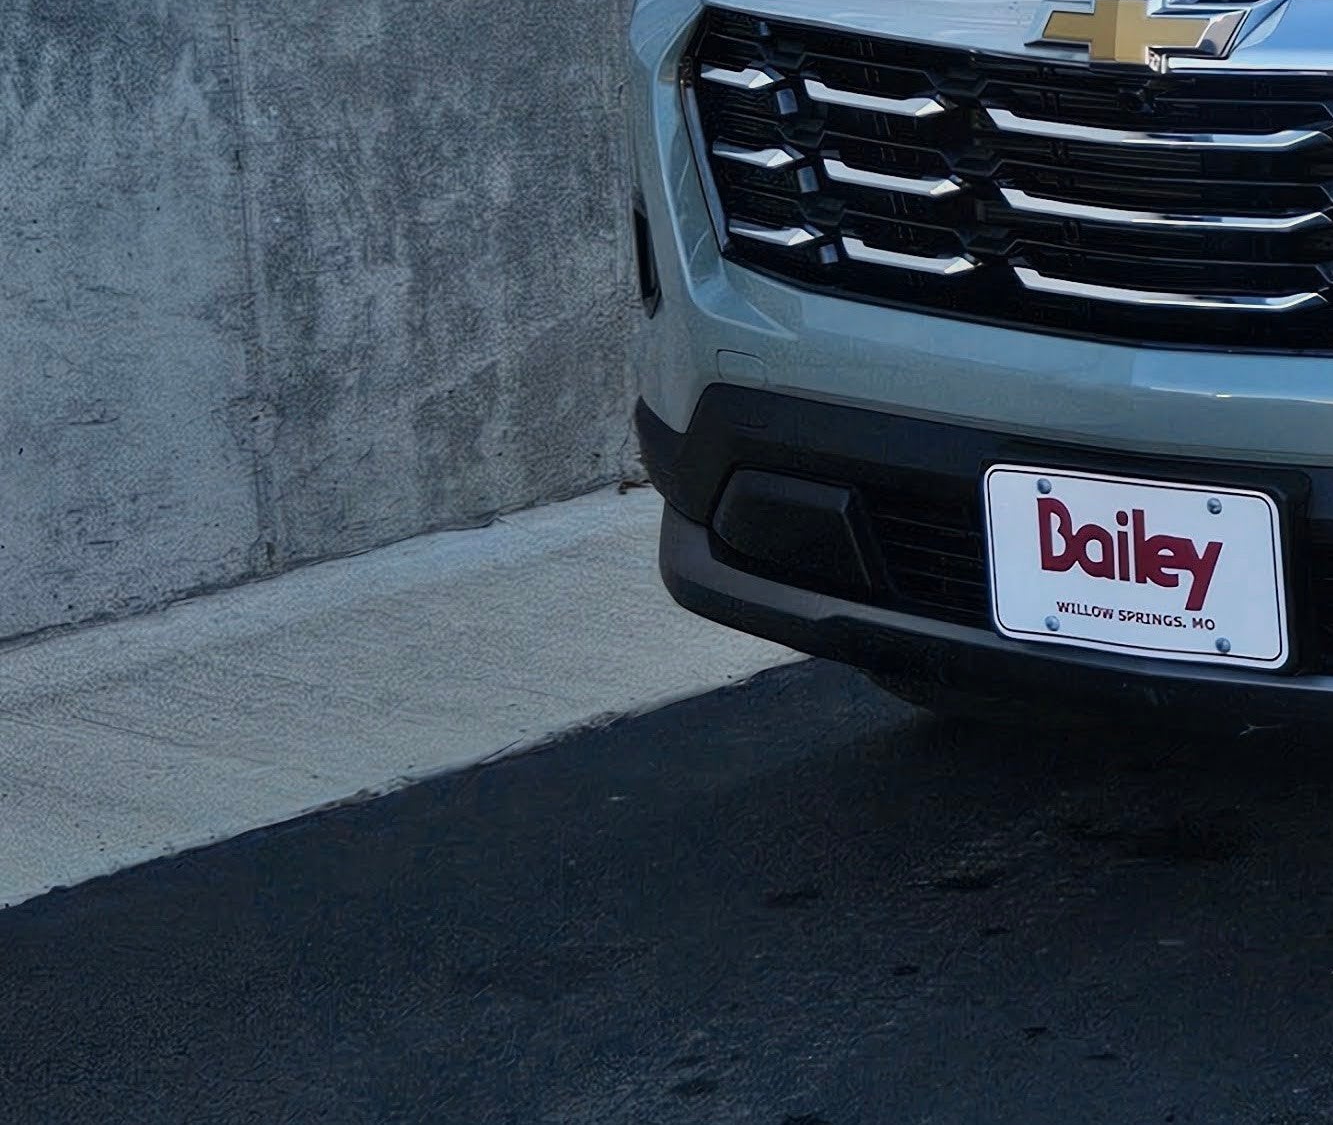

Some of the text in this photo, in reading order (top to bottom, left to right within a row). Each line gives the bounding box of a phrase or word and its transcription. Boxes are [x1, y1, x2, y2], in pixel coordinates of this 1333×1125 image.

[1037, 498, 1223, 611] Bailey
[1056, 601, 1114, 620] WILLOW
[1192, 617, 1216, 631] MO
